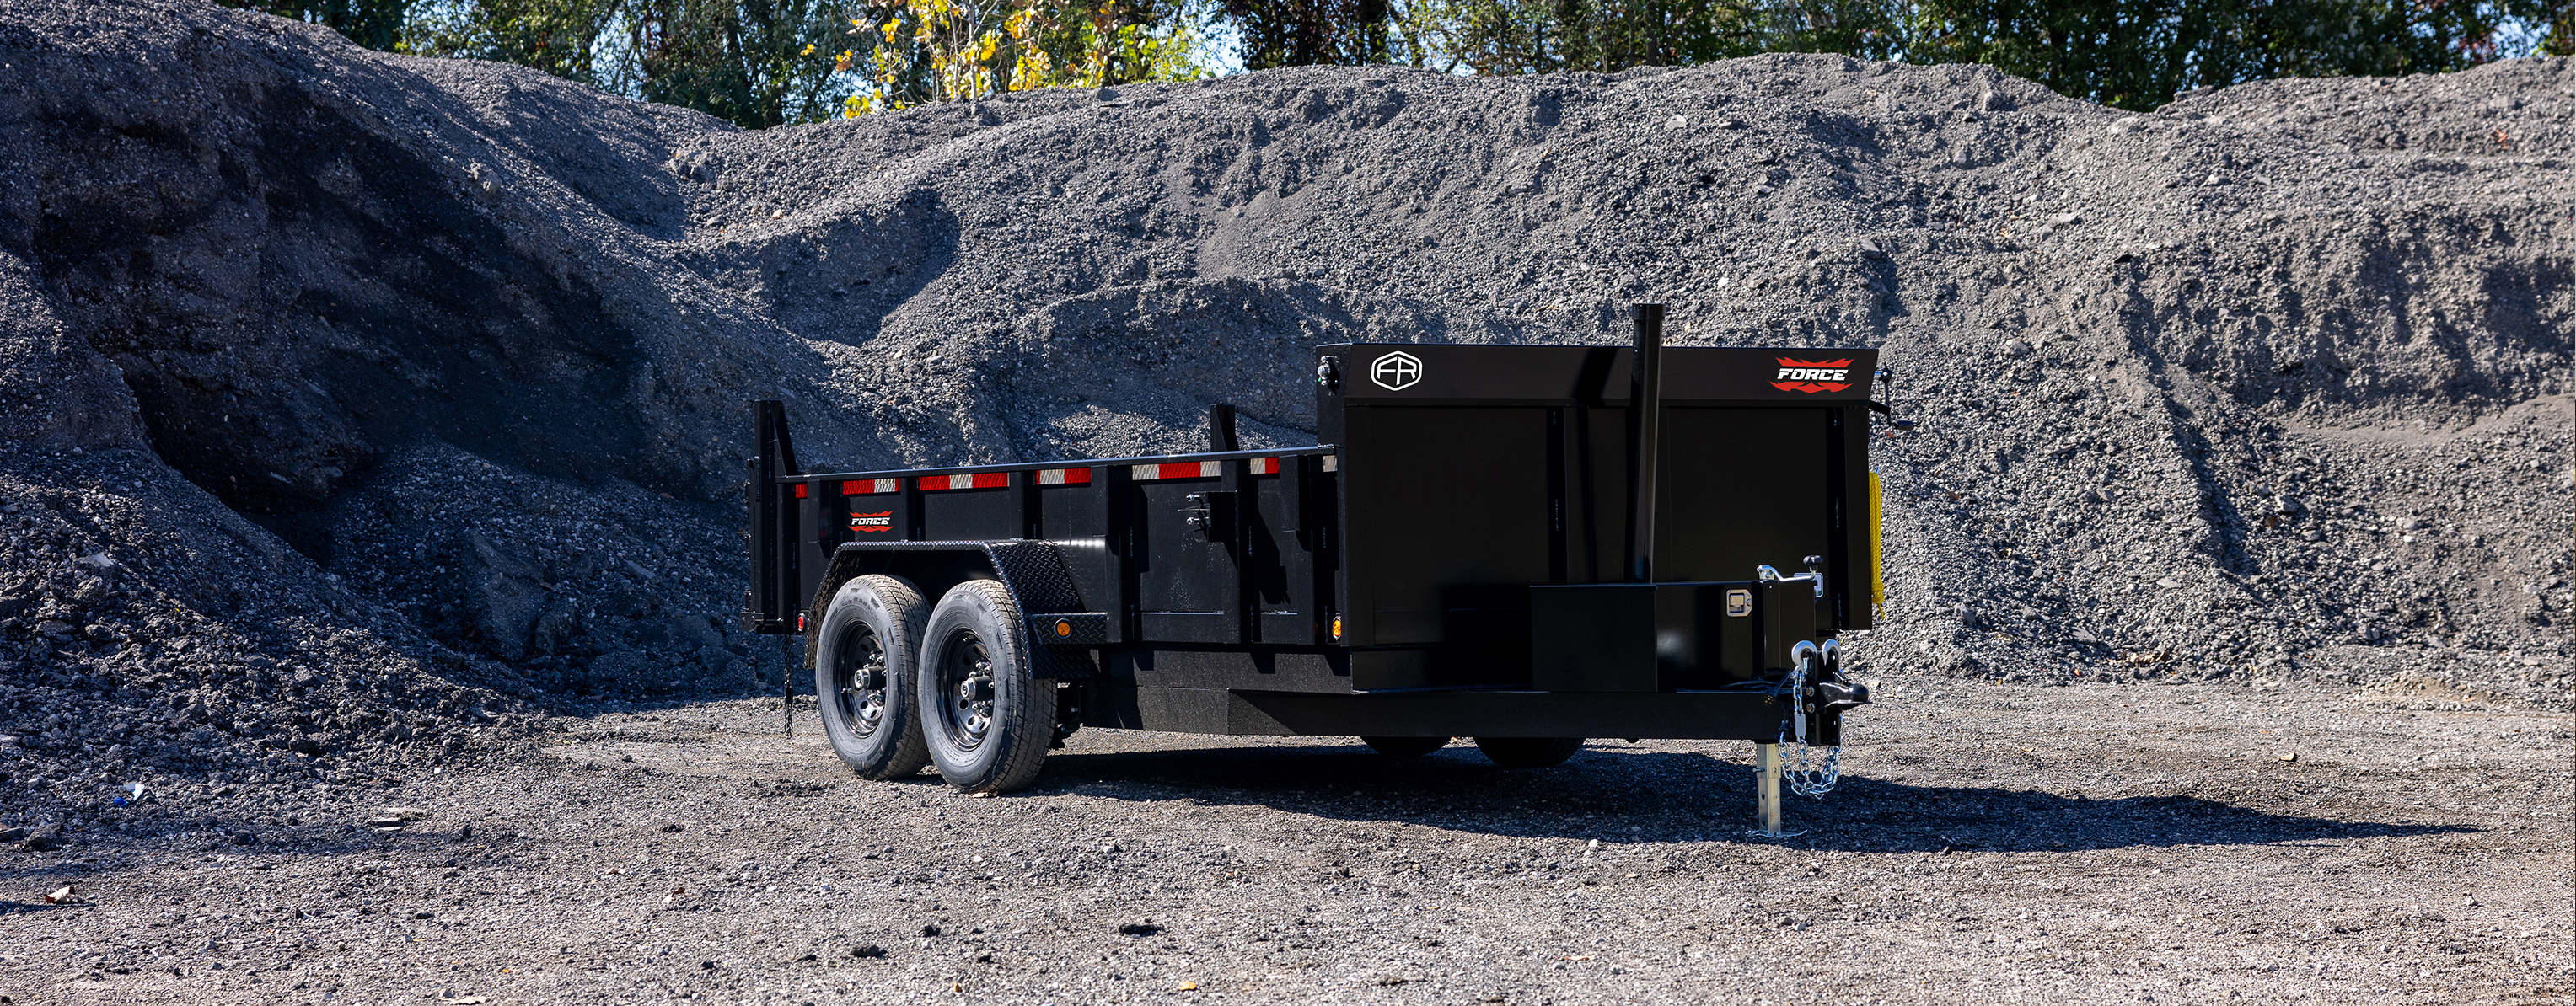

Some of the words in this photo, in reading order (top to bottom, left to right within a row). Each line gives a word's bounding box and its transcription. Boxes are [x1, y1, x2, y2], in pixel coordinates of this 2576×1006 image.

[1376, 356, 1418, 386] FR
[1776, 367, 1849, 382] FORCE
[851, 516, 891, 526] FORCE
